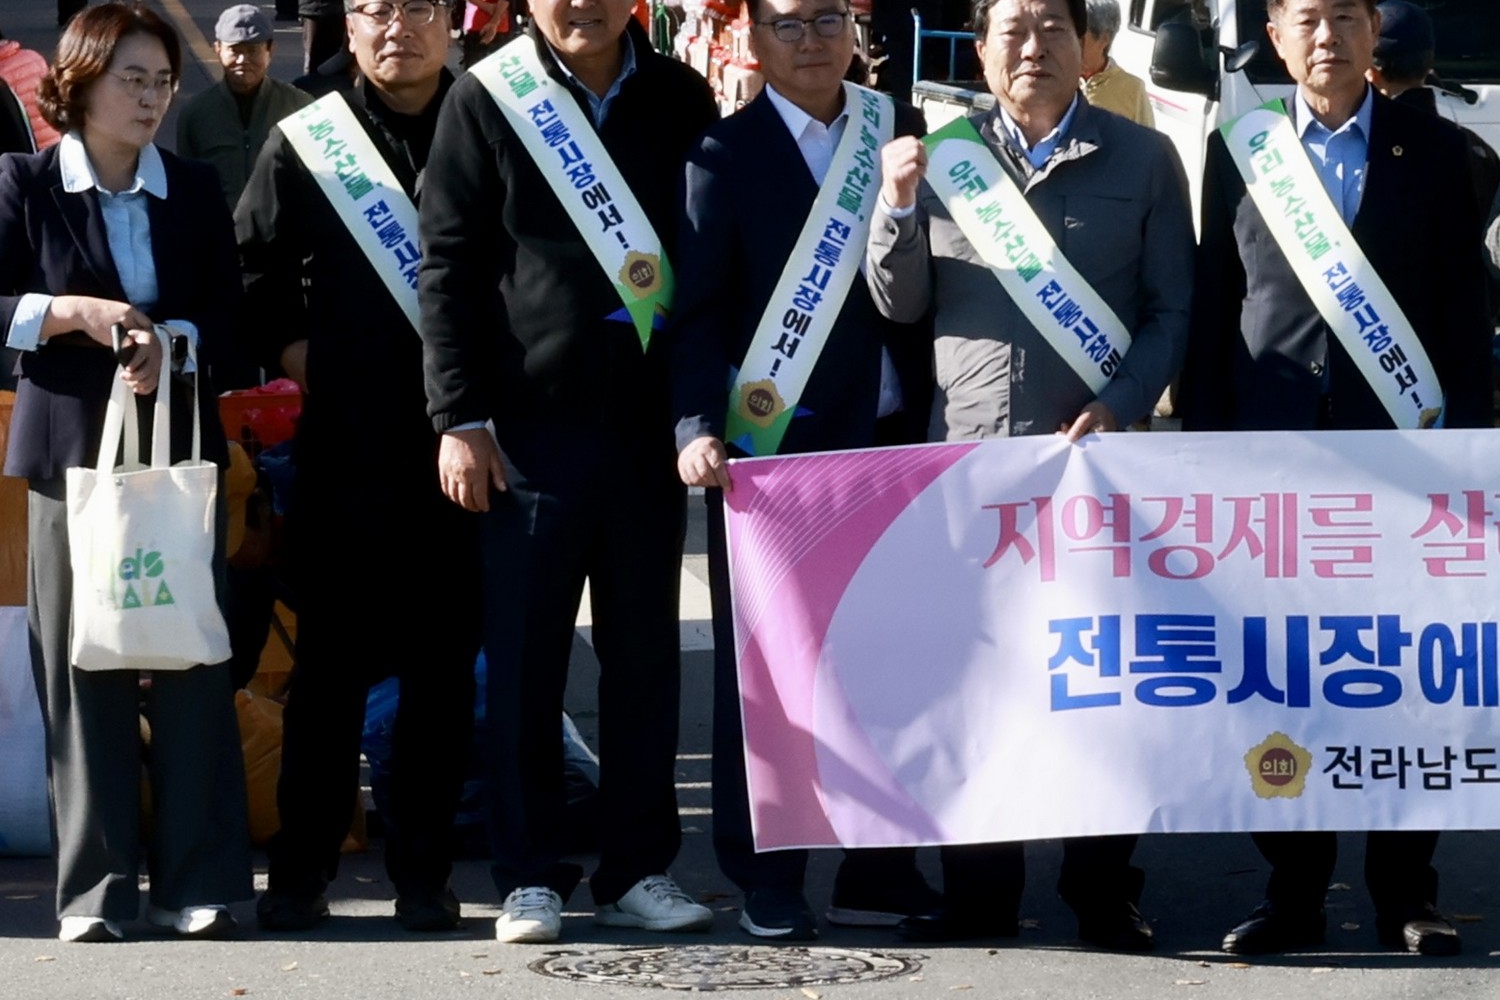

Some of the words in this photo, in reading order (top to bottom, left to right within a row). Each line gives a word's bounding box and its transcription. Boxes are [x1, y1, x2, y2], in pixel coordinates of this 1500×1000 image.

[307, 119, 384, 201] 농수산물,
[526, 98, 630, 250] 전통시장에서!
[837, 123, 881, 223] 농수산물,
[948, 160, 989, 202] 우리
[975, 200, 1055, 283] 농수산물,
[1248, 129, 1284, 175] 우리
[1269, 175, 1342, 261] 농수산물,
[1321, 261, 1423, 409] 전통시장에서!
[769, 217, 851, 378] 전통시장에서!
[981, 491, 1382, 583] 지역경제를
[1262, 758, 1294, 776] 의회
